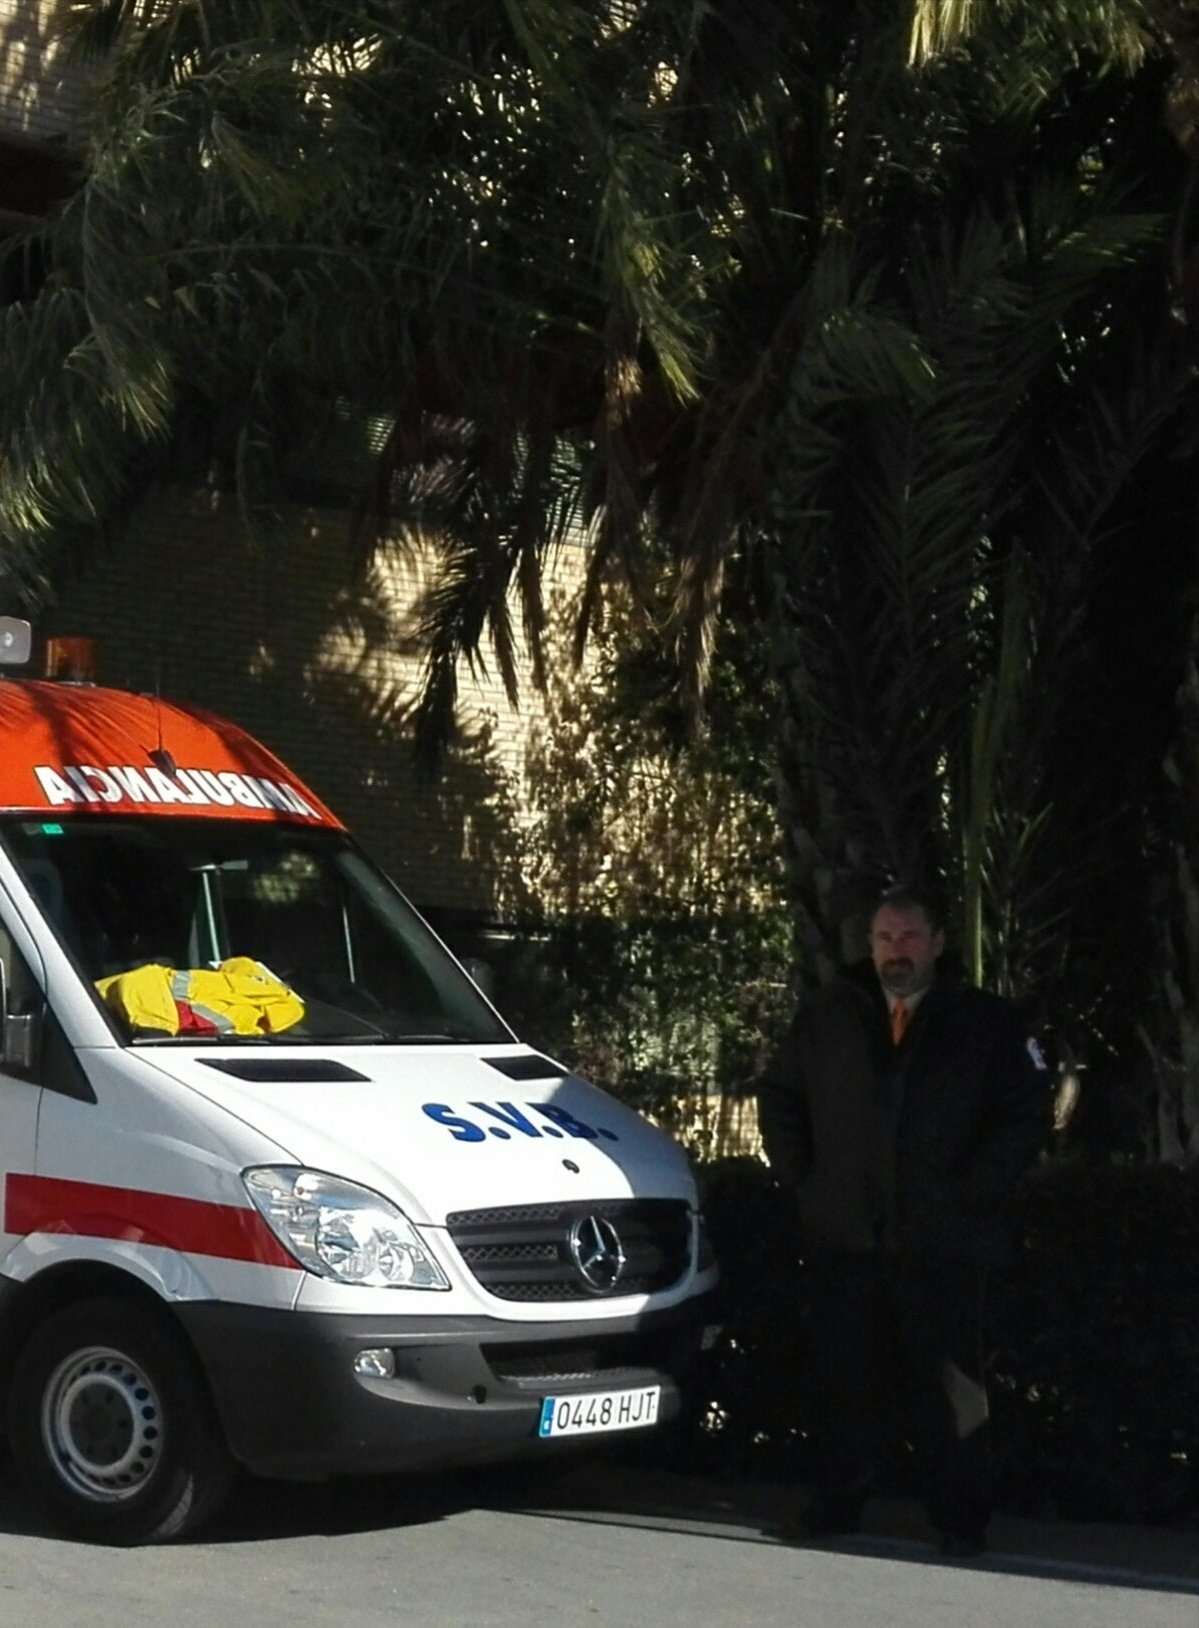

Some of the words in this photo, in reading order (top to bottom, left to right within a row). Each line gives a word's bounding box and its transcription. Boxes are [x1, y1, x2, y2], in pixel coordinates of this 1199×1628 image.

[421, 1101, 620, 1142] S.V.B.
[557, 1397, 613, 1430] 0448
[618, 1391, 656, 1424] HJT
